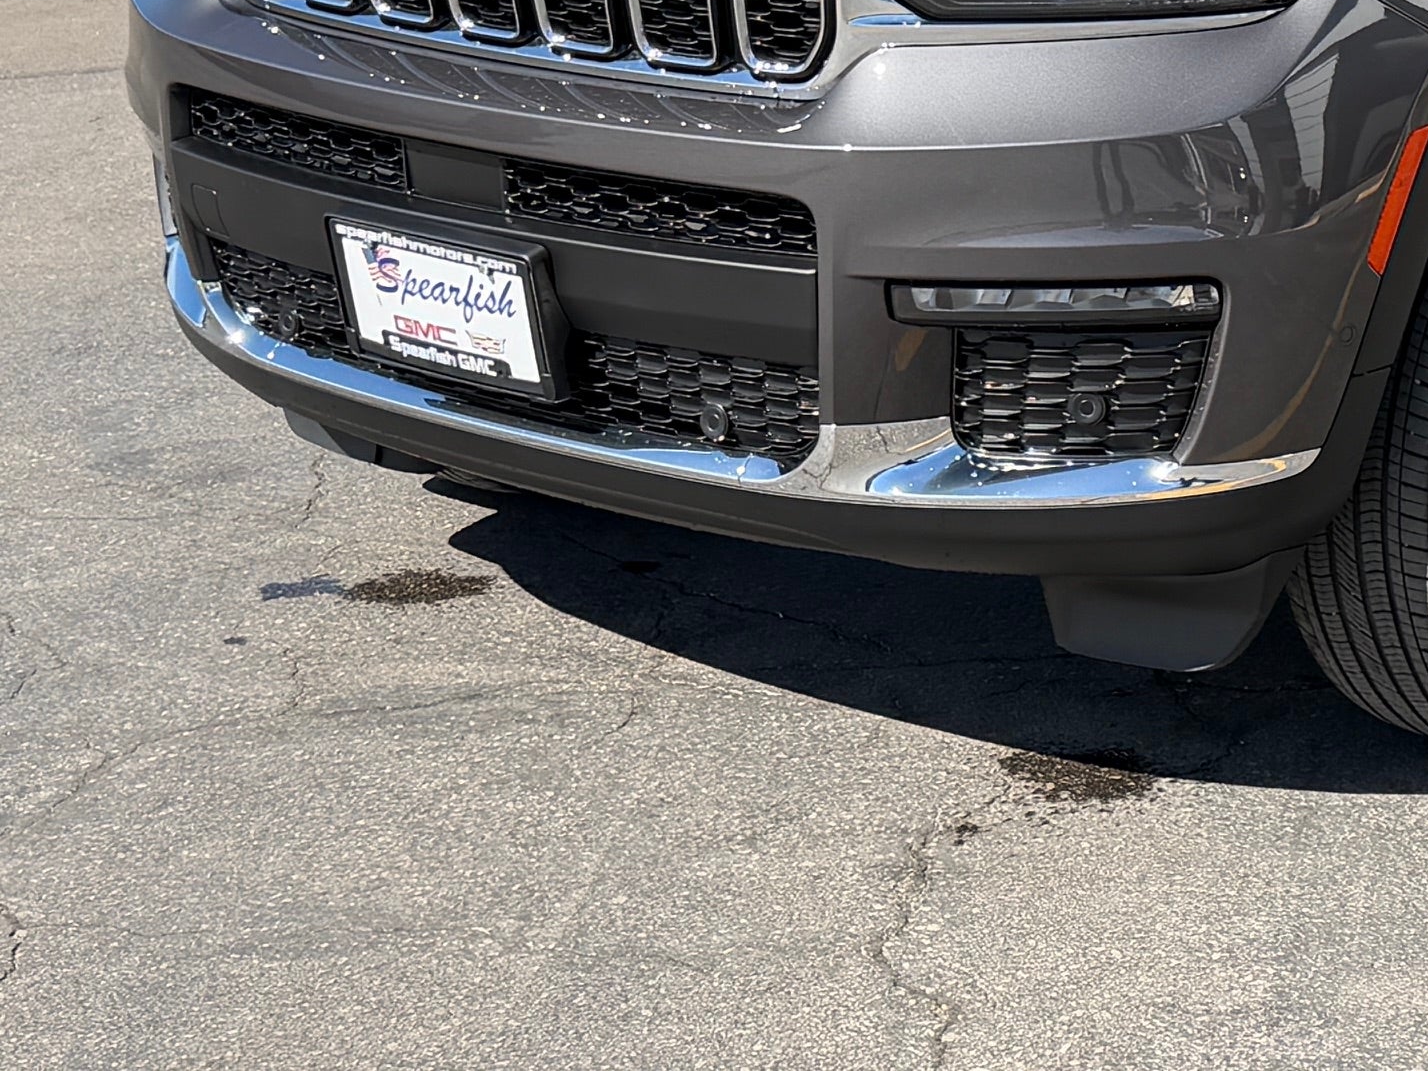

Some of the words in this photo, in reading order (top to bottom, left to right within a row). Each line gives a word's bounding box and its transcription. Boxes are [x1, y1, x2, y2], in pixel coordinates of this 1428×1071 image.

[335, 223, 517, 275] spearfishmotors.com
[376, 258, 517, 323] Spearfish
[393, 314, 458, 346] GMC
[389, 335, 456, 366] Spearfish
[458, 350, 499, 377] GMC
